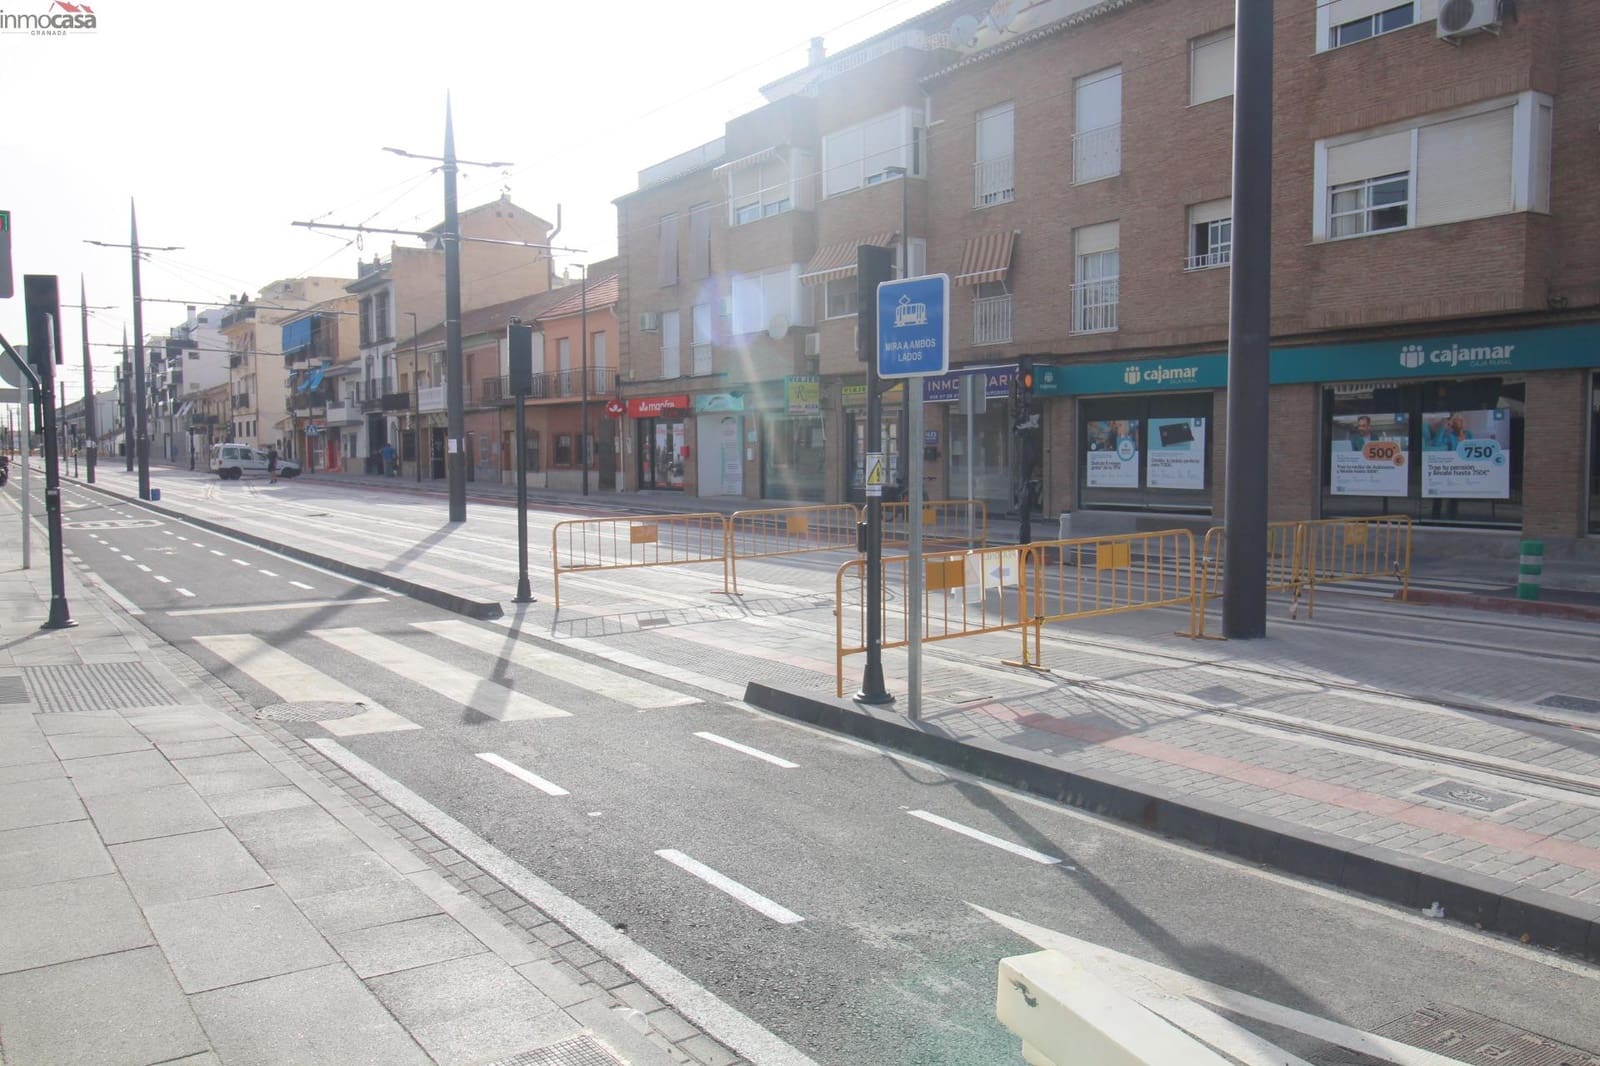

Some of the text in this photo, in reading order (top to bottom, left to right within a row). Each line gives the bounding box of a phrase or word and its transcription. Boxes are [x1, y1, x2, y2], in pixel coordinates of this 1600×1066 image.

[885, 337, 936, 352] MIRA A AMBOS
[897, 351, 923, 362] LADOS
[1429, 343, 1515, 367] cajamar
[1143, 364, 1200, 384] cajamar
[1369, 447, 1394, 458] 500
[1464, 446, 1493, 458] 750
